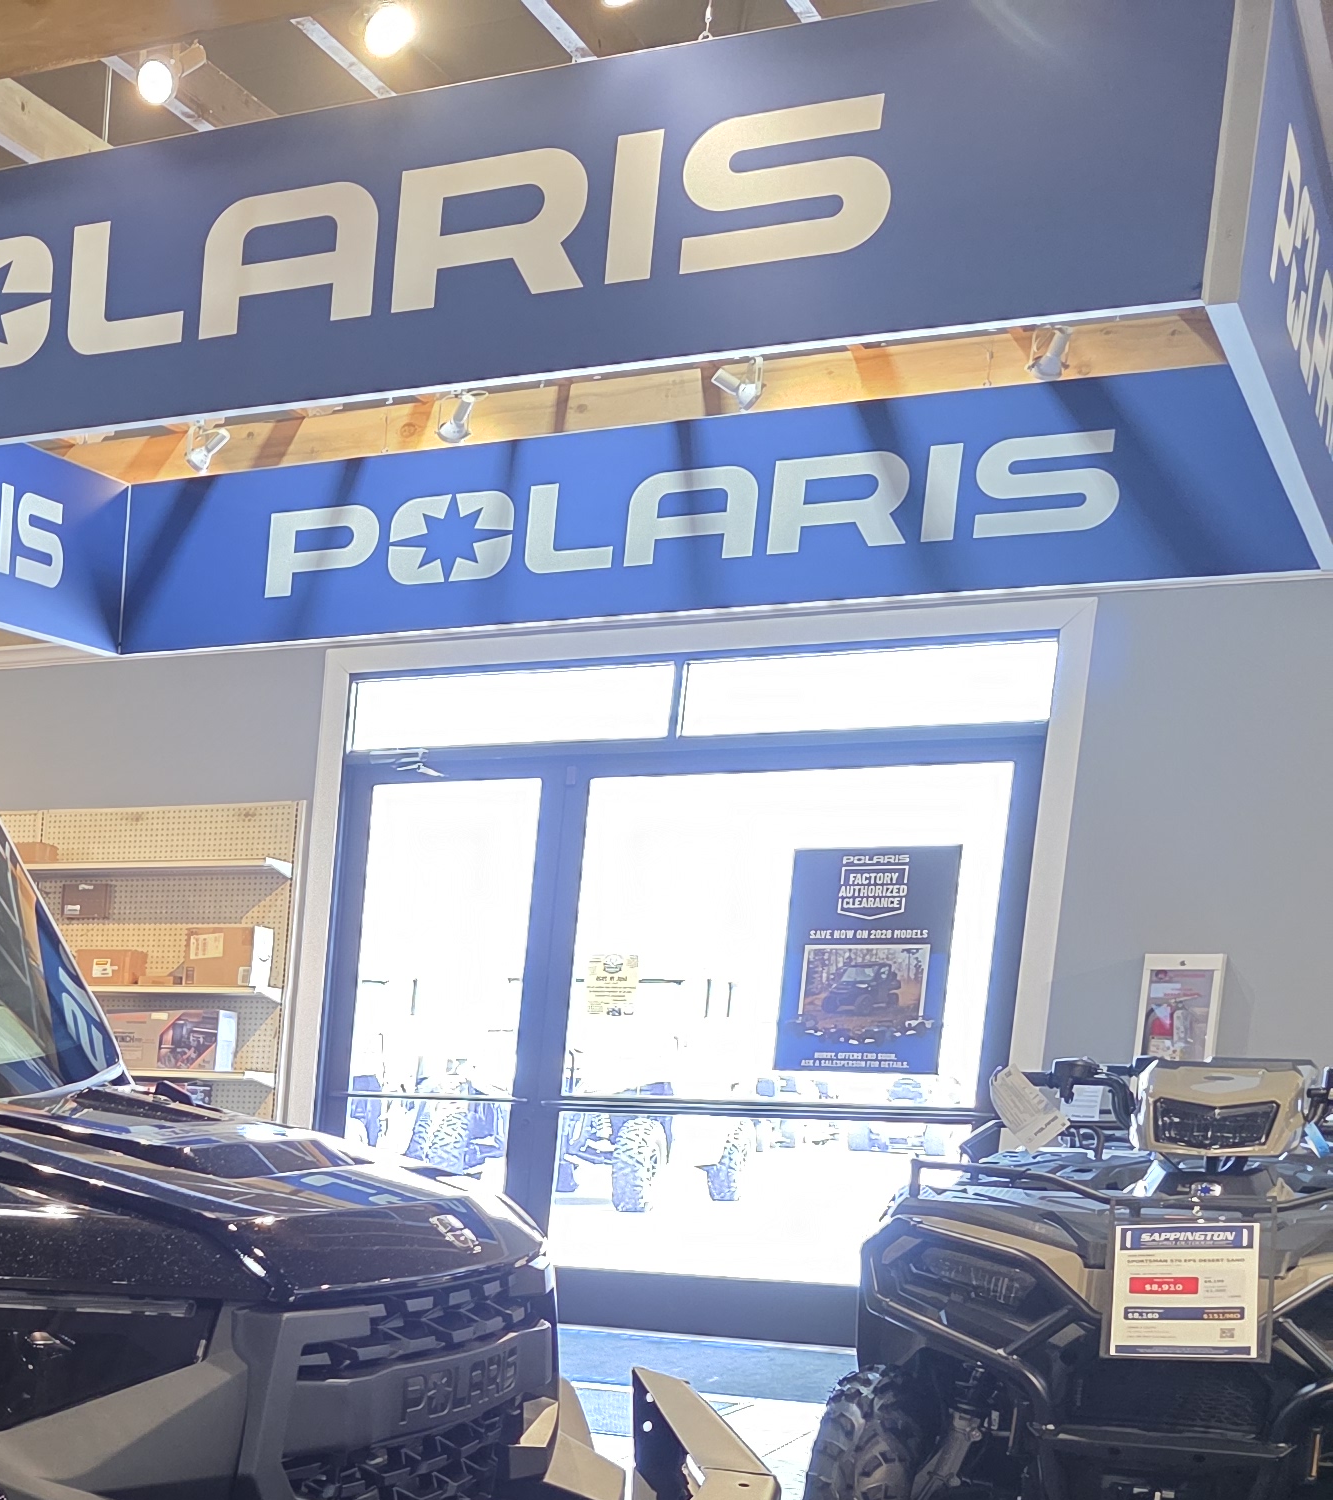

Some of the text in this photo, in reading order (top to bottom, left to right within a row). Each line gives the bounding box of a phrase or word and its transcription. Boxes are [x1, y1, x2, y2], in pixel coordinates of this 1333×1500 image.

[264, 429, 1120, 598] POLARIS
[842, 854, 910, 865] POLARIS
[849, 873, 899, 885] FACTORY
[839, 884, 908, 897] AUTHORIZED
[843, 897, 900, 909] CLEARANCE
[809, 930, 832, 939] SAVE
[834, 930, 854, 938] NOW
[856, 930, 869, 938] ON
[893, 929, 929, 938] MODELS
[821, 1060, 866, 1068] SALESPERSON
[867, 1060, 879, 1068] FOR
[881, 1061, 909, 1069] DETAILS.
[1140, 1231, 1236, 1242] SAPPINGTON
[1144, 1283, 1183, 1292] $8,910
[399, 1346, 518, 1425] POLARIS
